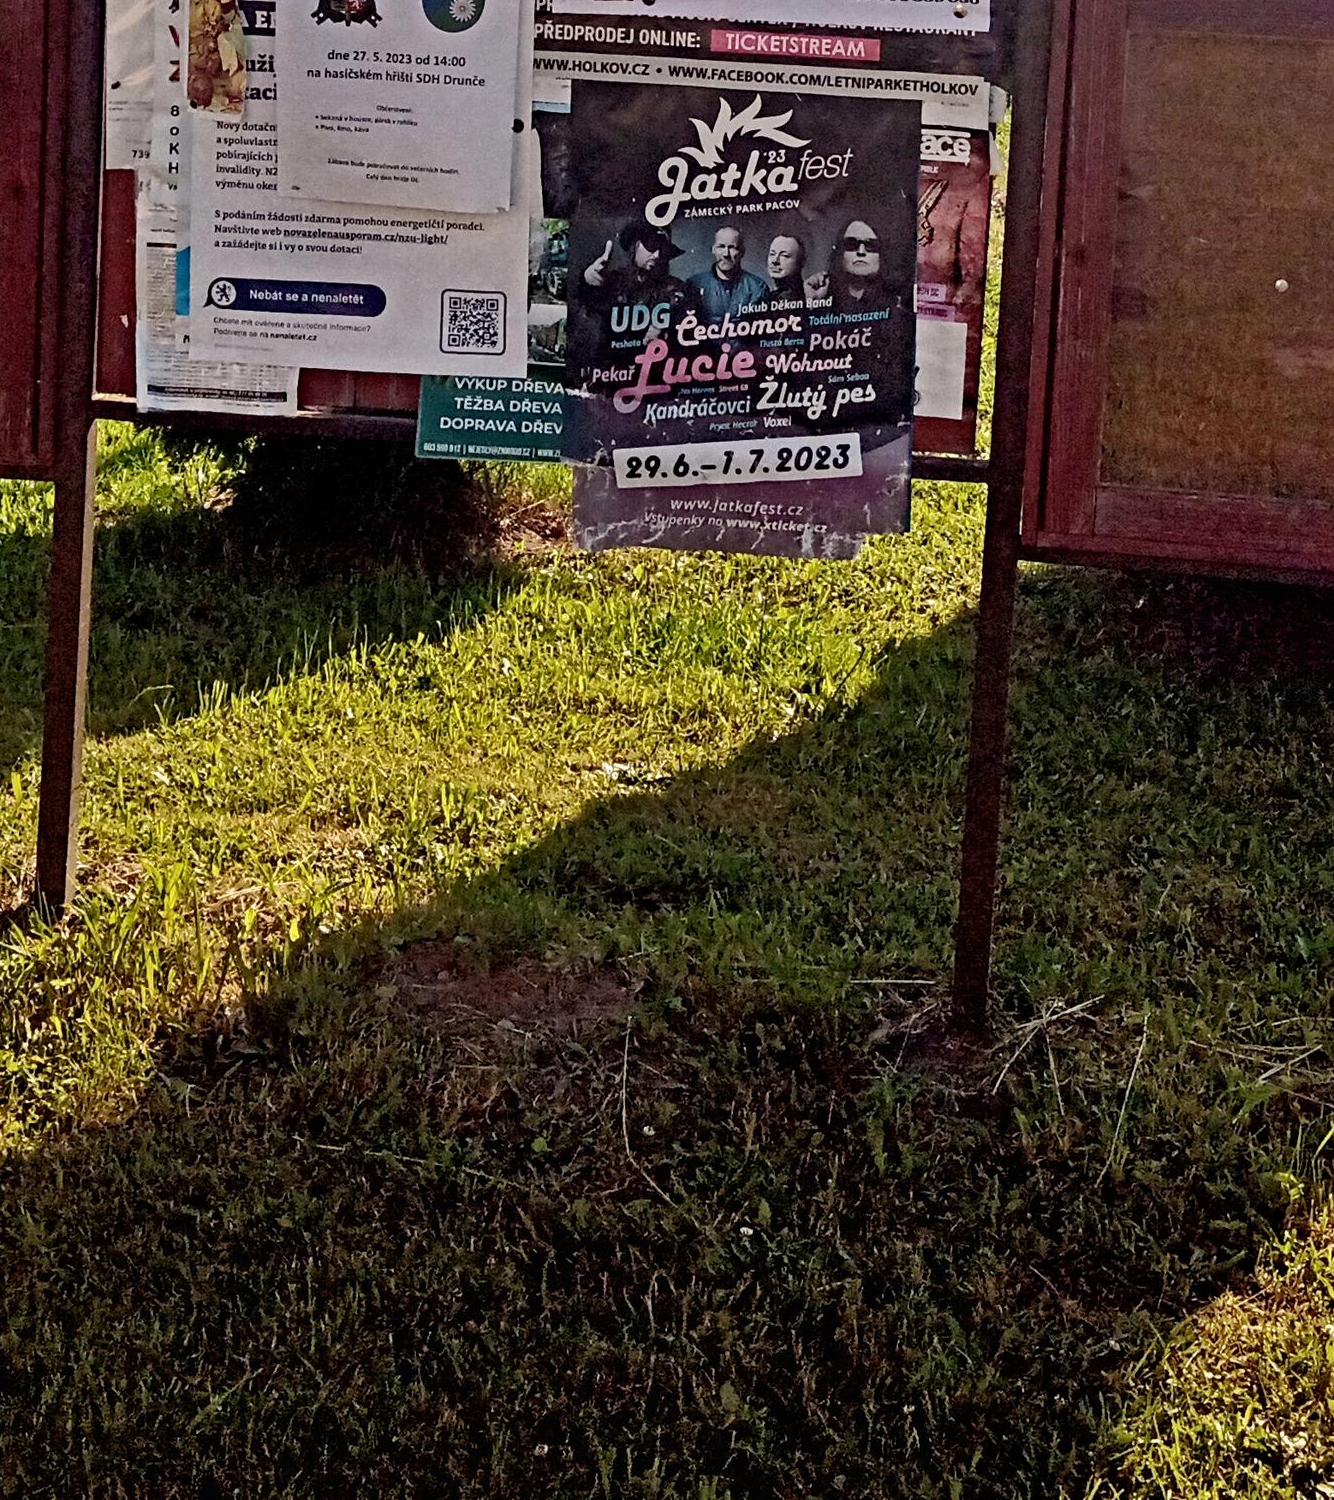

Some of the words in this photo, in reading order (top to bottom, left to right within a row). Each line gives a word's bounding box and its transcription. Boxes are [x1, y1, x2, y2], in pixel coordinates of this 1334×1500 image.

[534, 20, 634, 44] PŘEDPRODEJ
[639, 29, 701, 48] ONLINE:
[726, 33, 865, 57] TICKETSTREAM
[328, 50, 349, 61] dne
[386, 53, 412, 64] 2023
[416, 54, 430, 65] od
[434, 56, 466, 67] 14:00
[325, 69, 382, 81] hasičském
[416, 73, 439, 84] SDH
[444, 75, 485, 87] Drunče
[533, 58, 650, 76] WWW.HOLKOV.CZ
[668, 65, 978, 96] WWW.FACEBOOK.COM/LETNIPARKETHOLKOV
[217, 150, 272, 162] pobírajících
[216, 178, 254, 189] výměnu
[645, 150, 798, 227] Jatka
[798, 148, 854, 180] fest
[684, 205, 732, 218] ZÁMECKÝ
[736, 203, 764, 214] PARK
[766, 200, 800, 211] PACOV
[215, 210, 220, 218] S
[223, 210, 266, 221] podáním
[305, 214, 341, 224] zdarma
[343, 217, 388, 227] pomohou
[446, 222, 485, 231] poradci.
[262, 227, 282, 235] web
[222, 239, 267, 251] zažádejte
[269, 241, 277, 250] si
[279, 241, 282, 249] i
[284, 244, 295, 253] vy
[250, 290, 282, 300] Nebát
[286, 293, 298, 301] se
[311, 293, 364, 304] nenaletět
[737, 303, 767, 317] Jakub
[770, 299, 803, 311] Děkan
[806, 296, 833, 308] Band
[611, 303, 670, 332] UDG
[809, 314, 843, 325] Totální
[675, 309, 802, 346] Čechomor
[810, 327, 872, 351] Pokáč
[766, 353, 853, 374] Wohnout
[592, 365, 635, 383] Pekař
[613, 339, 757, 414] Lucie
[512, 378, 564, 394] DŘEVA
[454, 396, 505, 411] TĚŽBA
[509, 399, 562, 415] DŘEVA
[757, 375, 827, 420] Žlutý
[832, 384, 876, 417] pes
[645, 396, 750, 421] Kandráčovci
[440, 417, 517, 433] DOPRAVA
[764, 416, 792, 428] Voxel
[644, 512, 705, 528] Vstupenky
[708, 516, 723, 527] na
